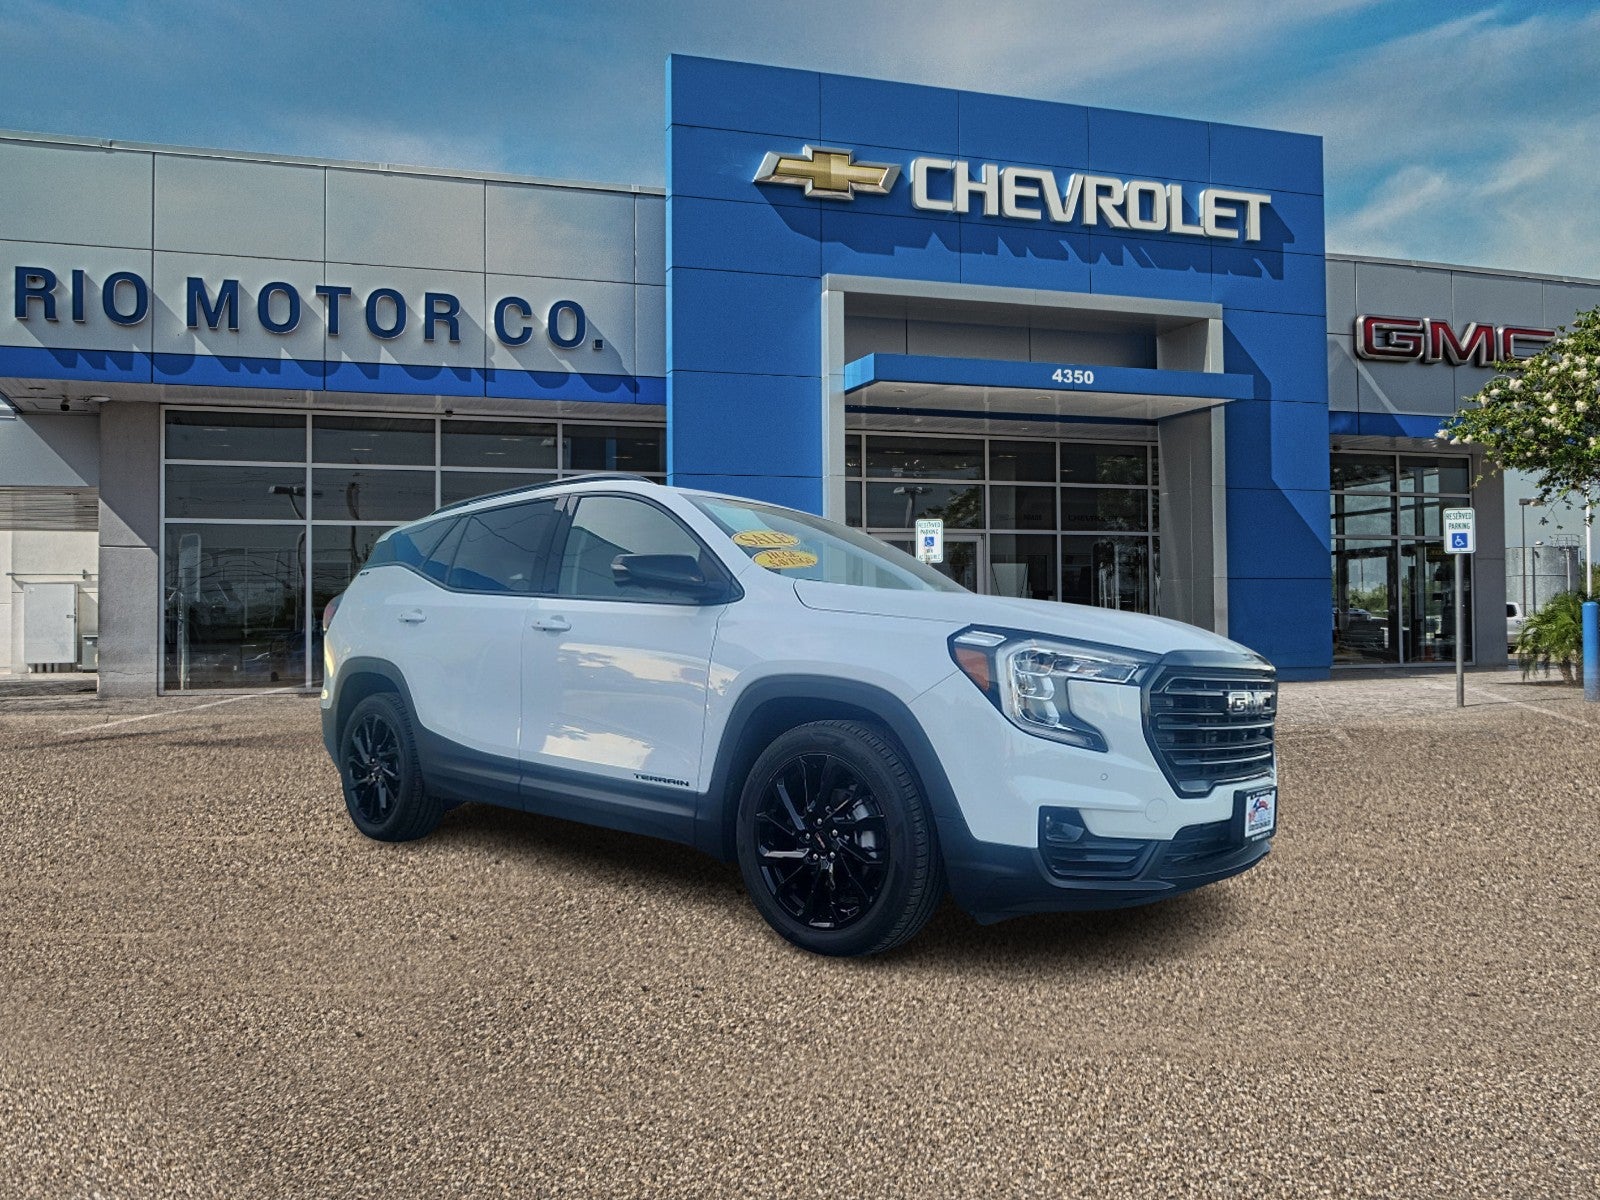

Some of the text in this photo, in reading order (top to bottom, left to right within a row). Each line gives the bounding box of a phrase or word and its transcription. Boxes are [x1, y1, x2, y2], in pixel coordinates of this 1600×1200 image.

[910, 156, 1273, 243] CHEVROLET
[14, 265, 604, 350] RIO MOTOR CO.
[1355, 313, 1559, 368] GMC
[1051, 368, 1095, 385] 4350
[1445, 511, 1472, 520] RESERVED
[1448, 522, 1471, 530] PARKING
[1228, 691, 1276, 714] GMC
[633, 773, 689, 787] TERRAIN
